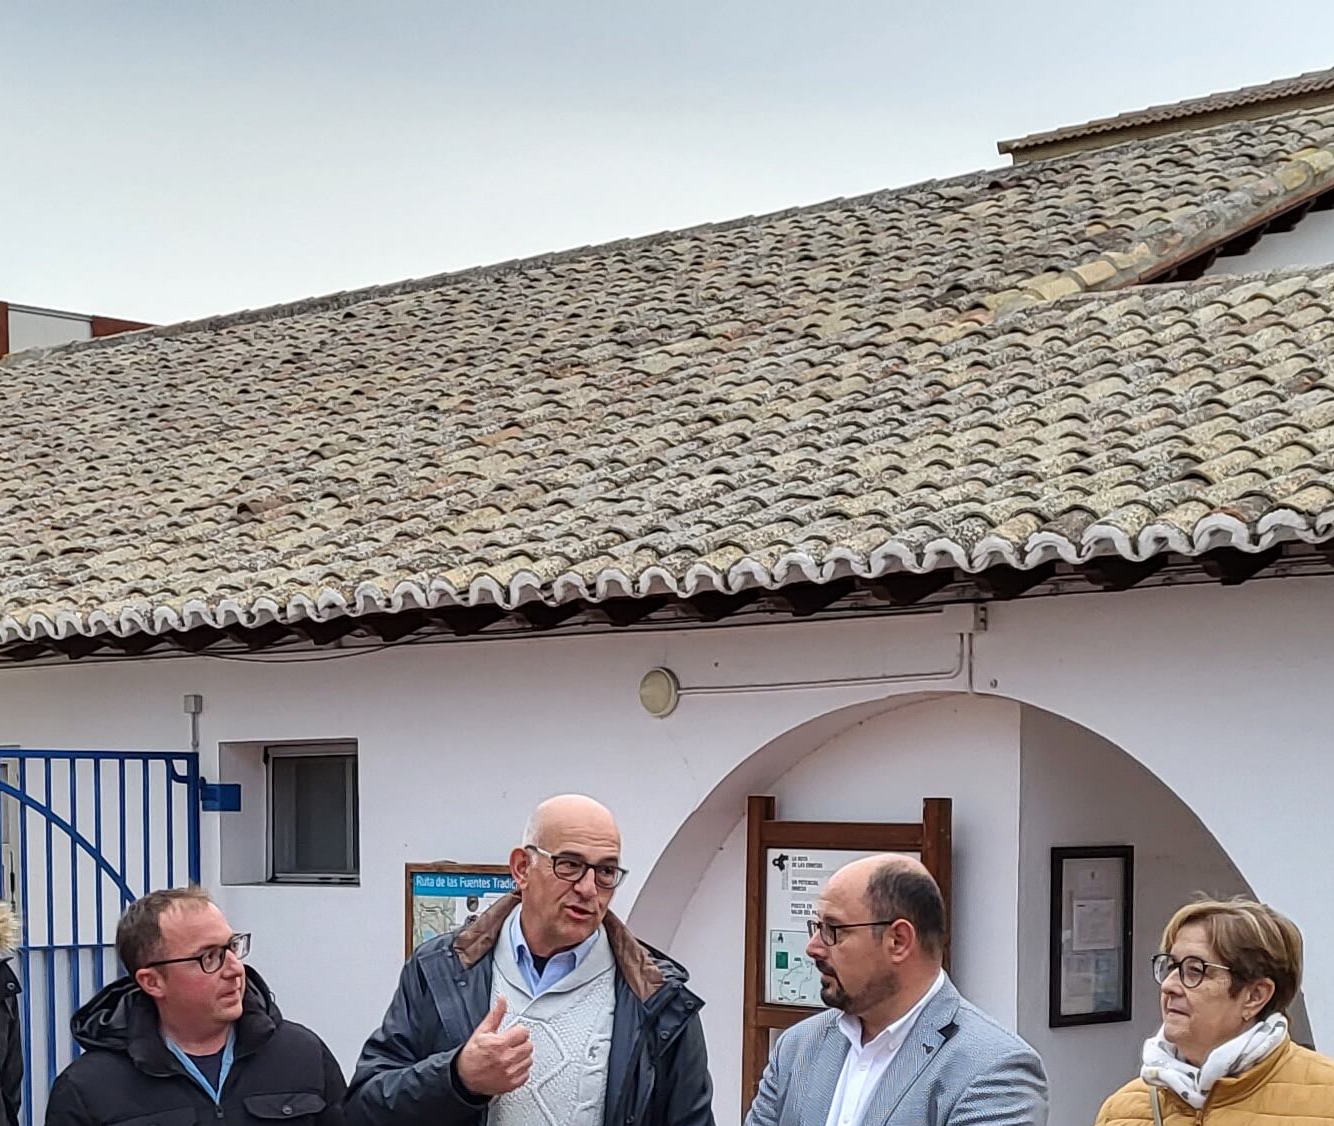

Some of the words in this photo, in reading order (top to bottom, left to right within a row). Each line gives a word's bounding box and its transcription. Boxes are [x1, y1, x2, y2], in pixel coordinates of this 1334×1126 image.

[416, 875, 434, 888] Ruta
[436, 876, 446, 888] de
[447, 876, 458, 888] las
[460, 877, 491, 889] Fuentes
